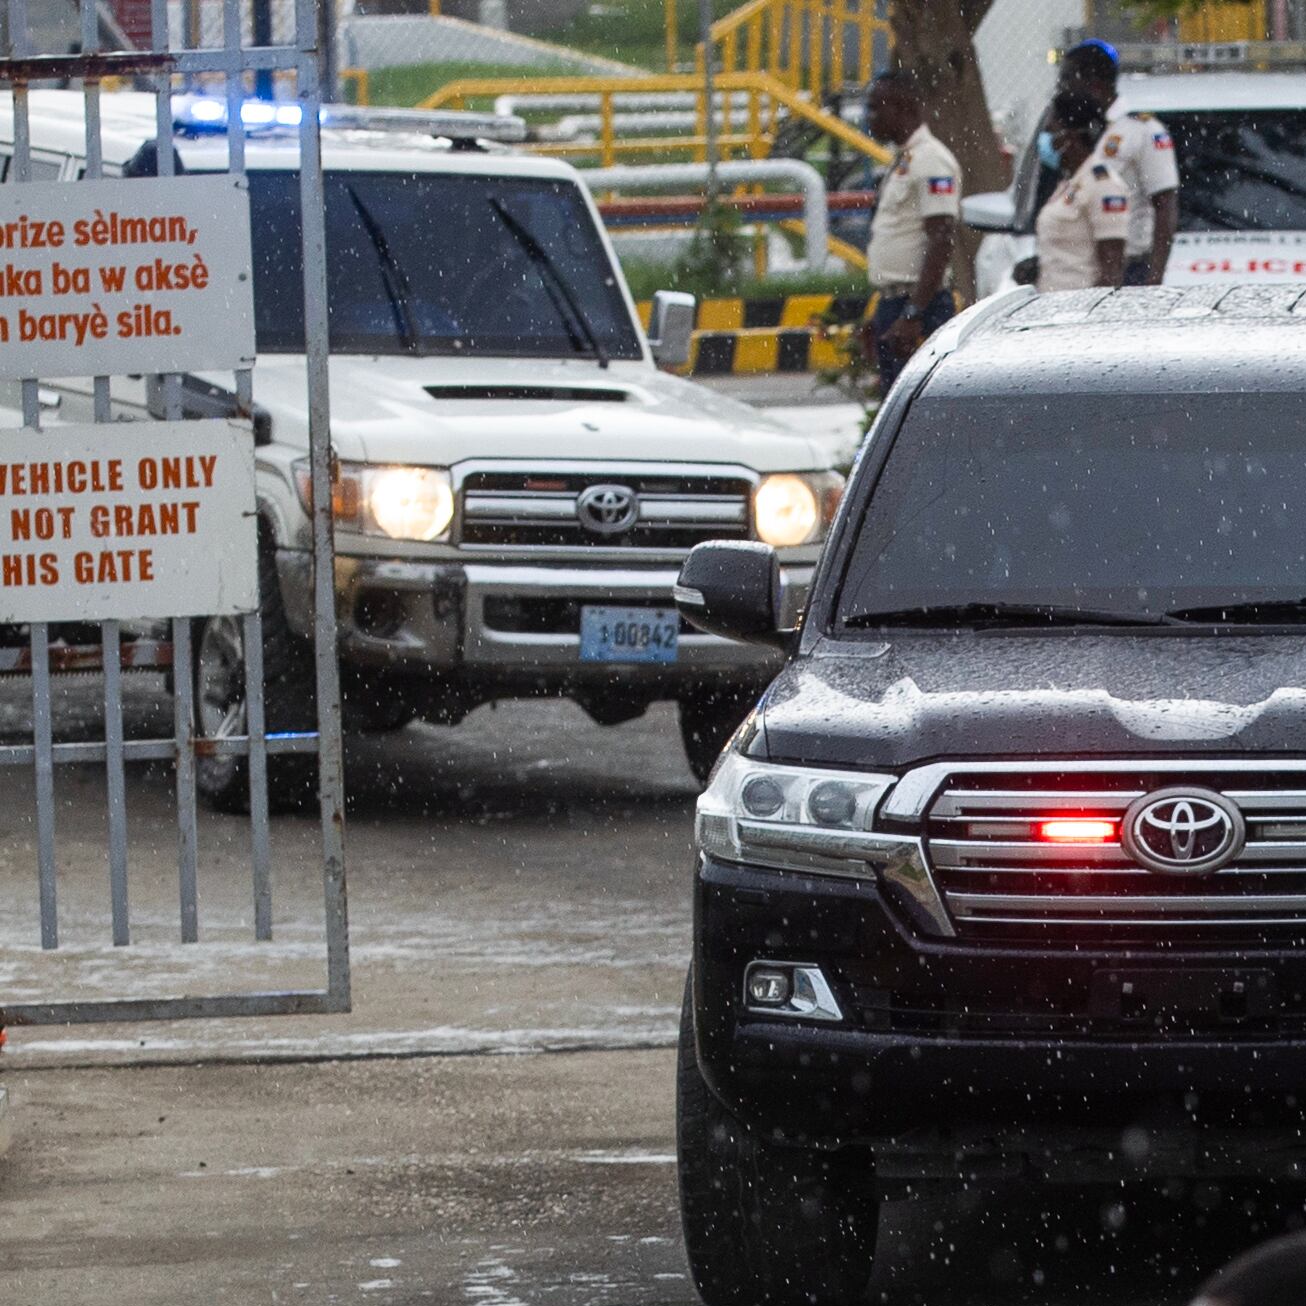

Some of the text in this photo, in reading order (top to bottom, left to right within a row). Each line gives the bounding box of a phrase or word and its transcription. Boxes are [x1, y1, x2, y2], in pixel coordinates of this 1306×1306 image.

[0, 210, 198, 248] rize sèlman,
[0, 255, 209, 297] ka ba w aksè
[19, 304, 108, 346] baryè
[117, 304, 182, 338] sila.
[138, 455, 218, 490] ONLY
[11, 501, 199, 541] NOT GRANT
[75, 548, 154, 584] GATE
